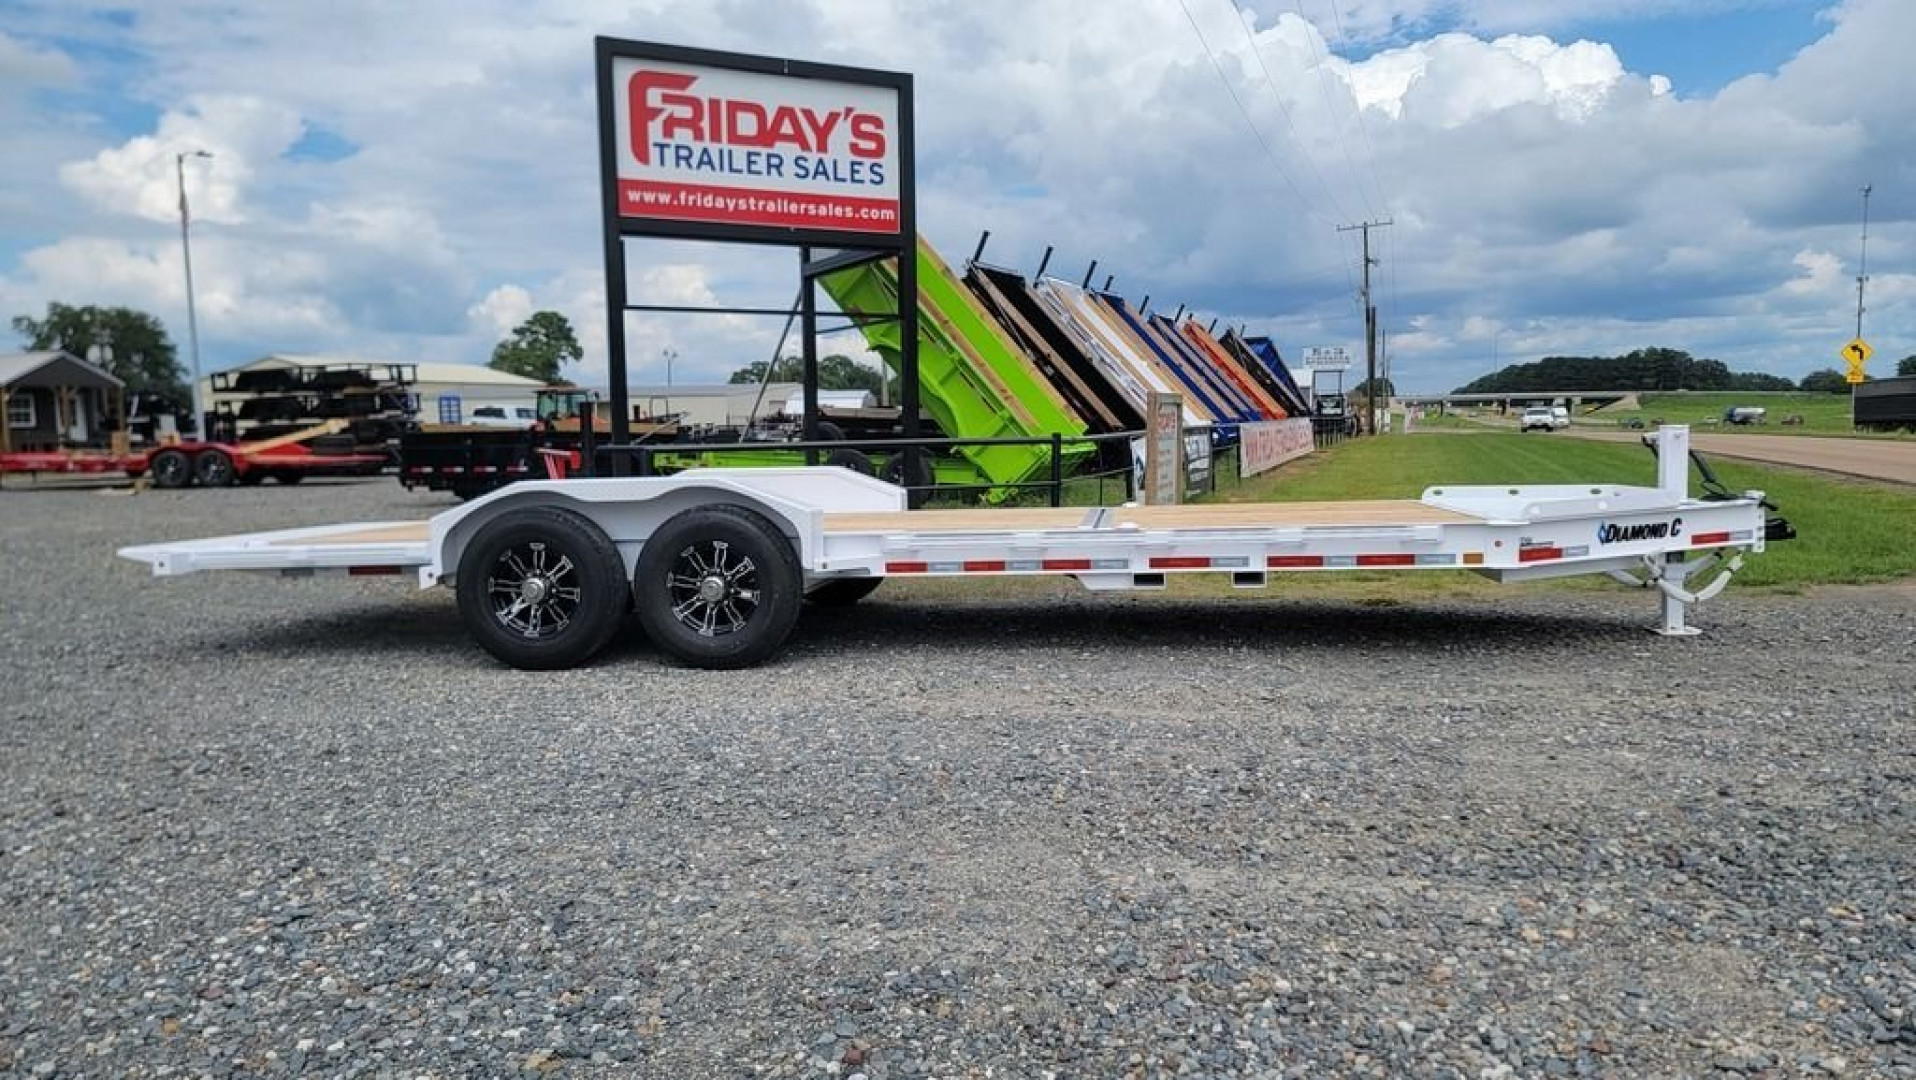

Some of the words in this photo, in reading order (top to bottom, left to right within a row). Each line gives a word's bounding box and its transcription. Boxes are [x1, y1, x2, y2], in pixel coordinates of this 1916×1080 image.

[628, 69, 886, 167] FRIDAY'S
[653, 142, 784, 178] TRAILER
[793, 156, 885, 186] SALES
[626, 188, 895, 221] www.fridaystrailersales.com
[1605, 521, 1668, 543] DIAMOND
[1670, 517, 1683, 538] C
